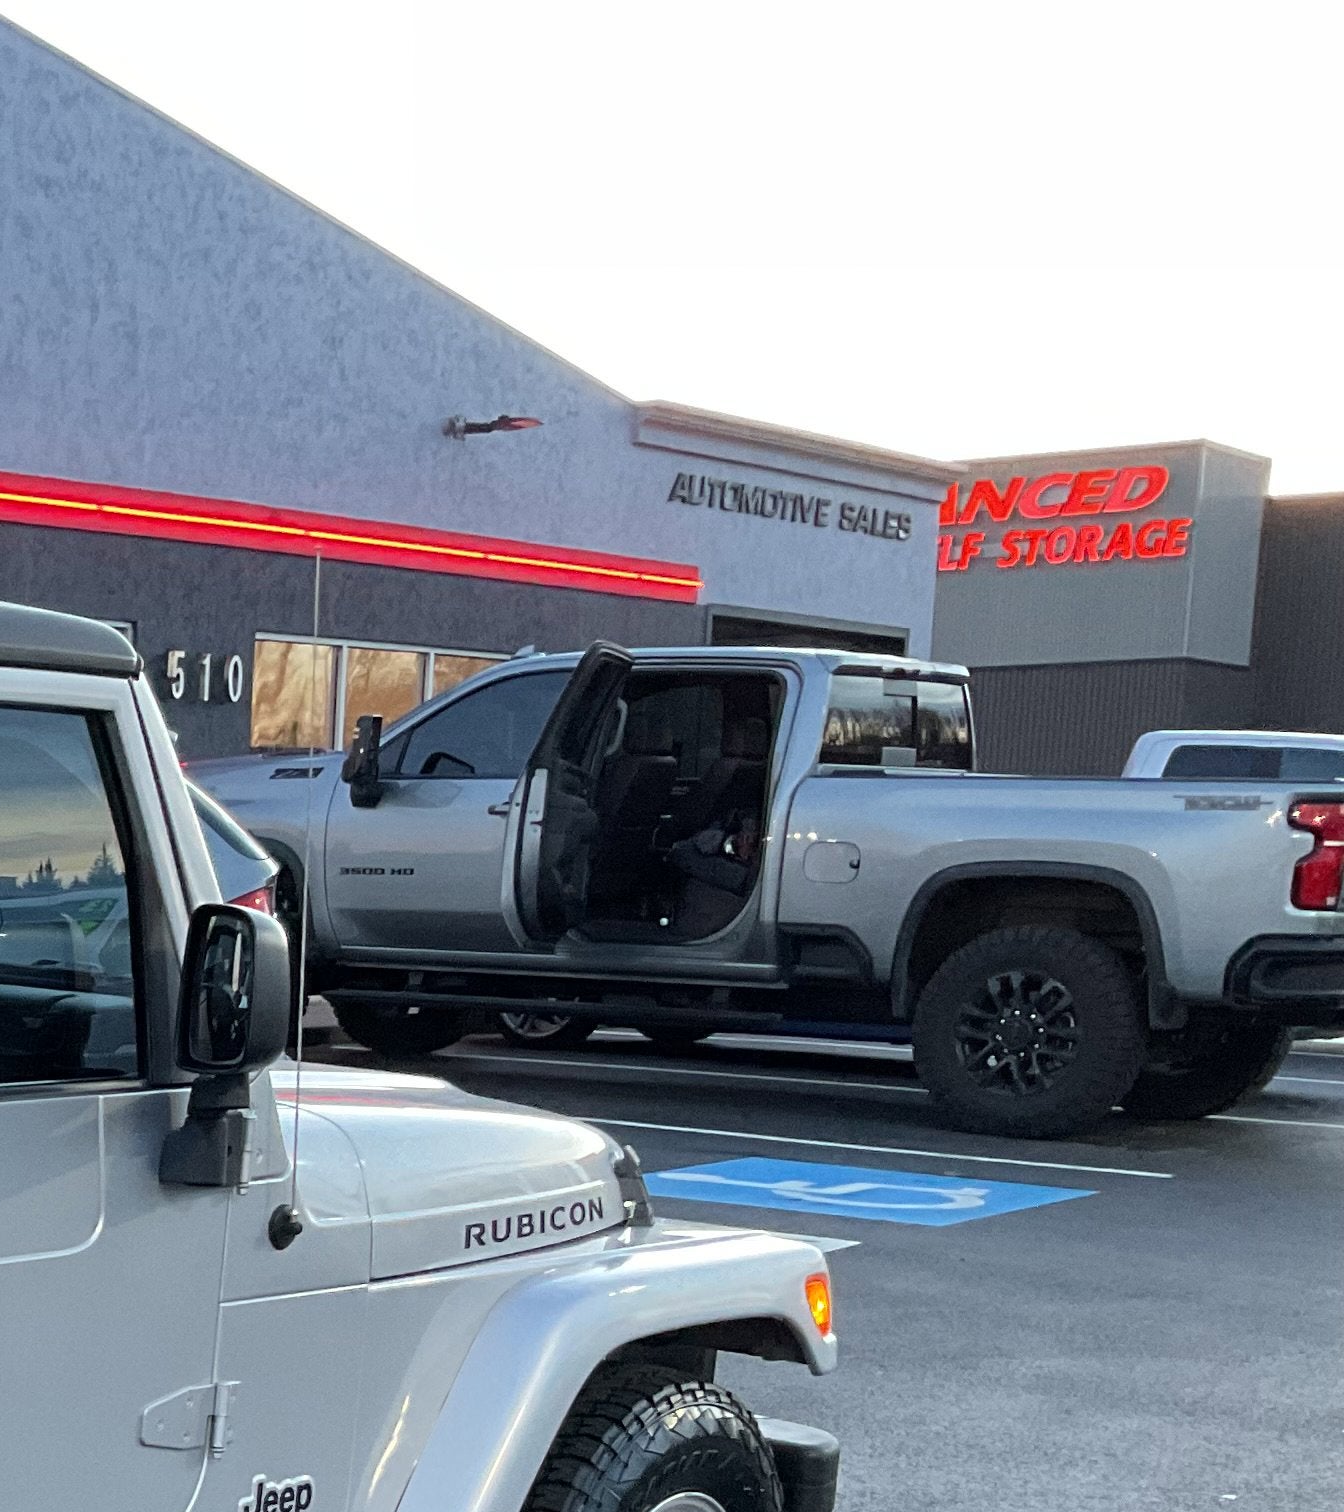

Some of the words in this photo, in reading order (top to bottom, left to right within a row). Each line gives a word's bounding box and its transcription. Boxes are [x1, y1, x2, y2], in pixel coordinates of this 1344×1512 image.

[667, 472, 831, 528] AUTOMOTIVE
[839, 502, 912, 541] SALES
[937, 533, 985, 571] LF
[996, 518, 1193, 569] STORAGE
[167, 650, 243, 702] 510
[340, 867, 385, 876] 3500
[464, 1196, 604, 1249] RUBICON
